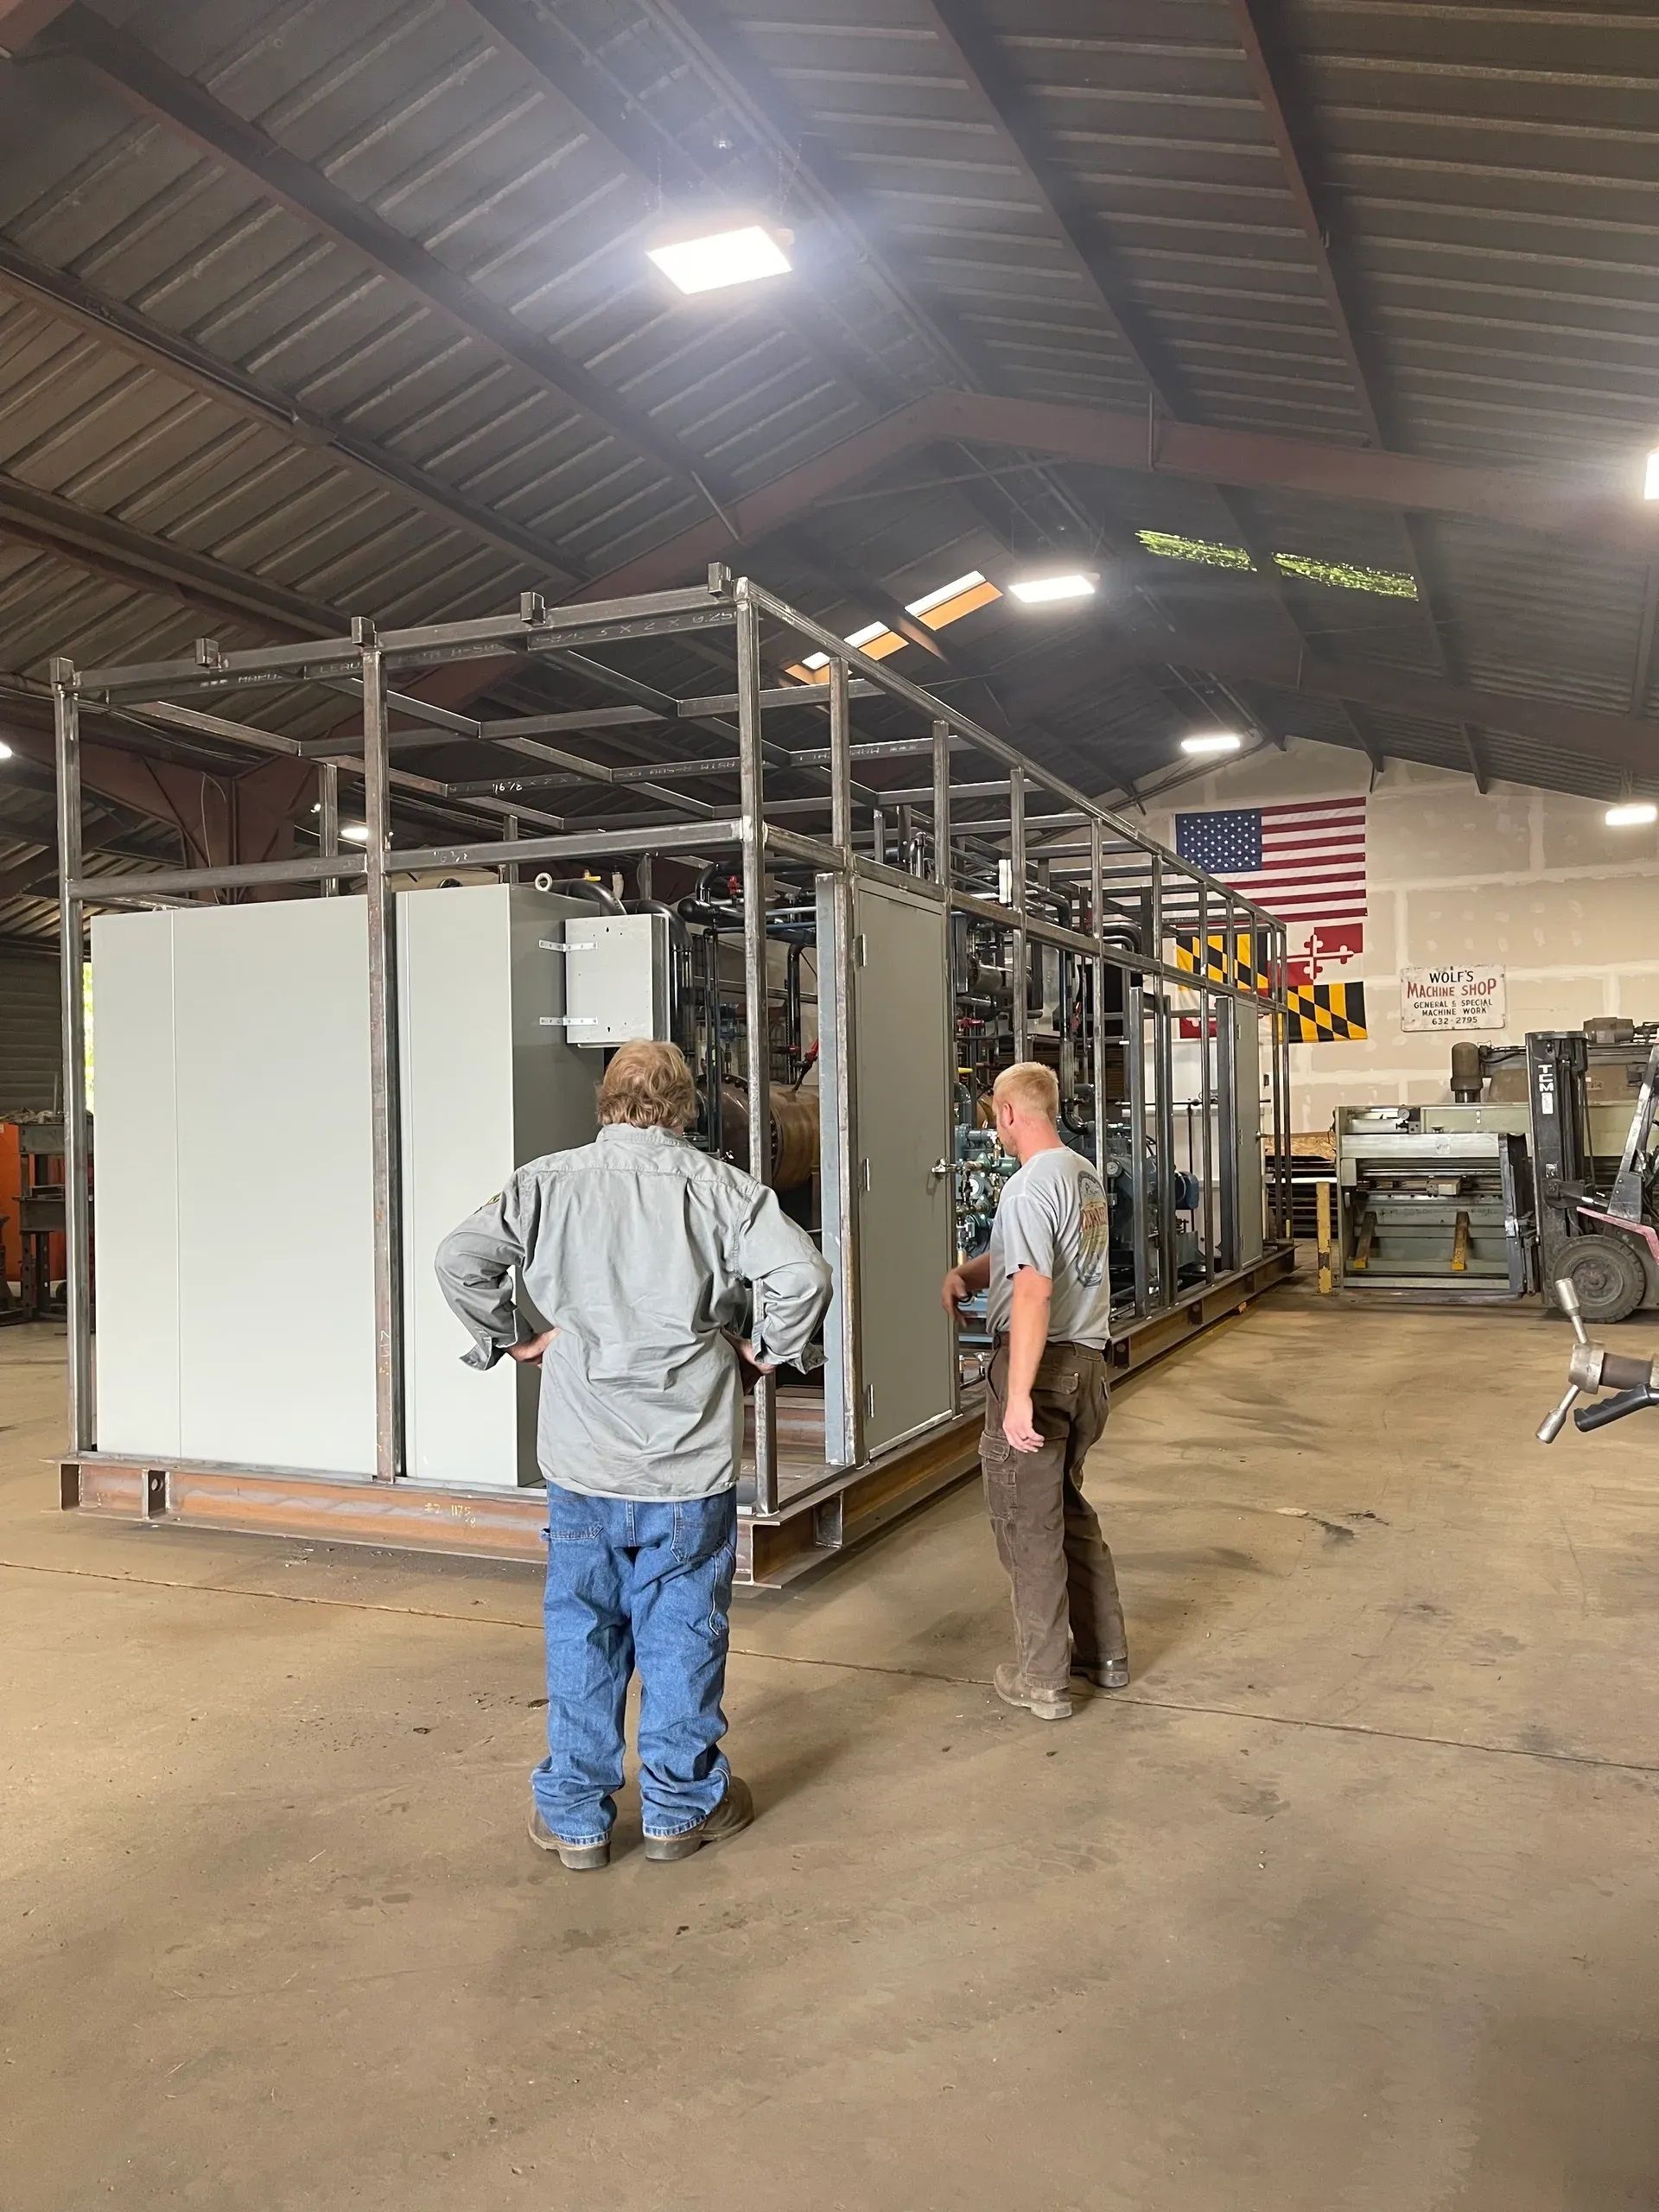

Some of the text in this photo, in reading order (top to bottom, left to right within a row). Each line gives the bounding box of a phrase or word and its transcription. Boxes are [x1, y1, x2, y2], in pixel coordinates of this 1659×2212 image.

[692, 610, 737, 624] 0.25
[1429, 969, 1474, 983] WOLF'S
[1407, 978, 1497, 999] MACHINE SHOP
[1414, 1001, 1448, 1009] GENERAL
[1461, 999, 1493, 1007] SPECIAL
[1463, 1007, 1487, 1015] WORK
[1432, 1016, 1478, 1026] 632-2795
[1538, 1064, 1554, 1092] TCM
